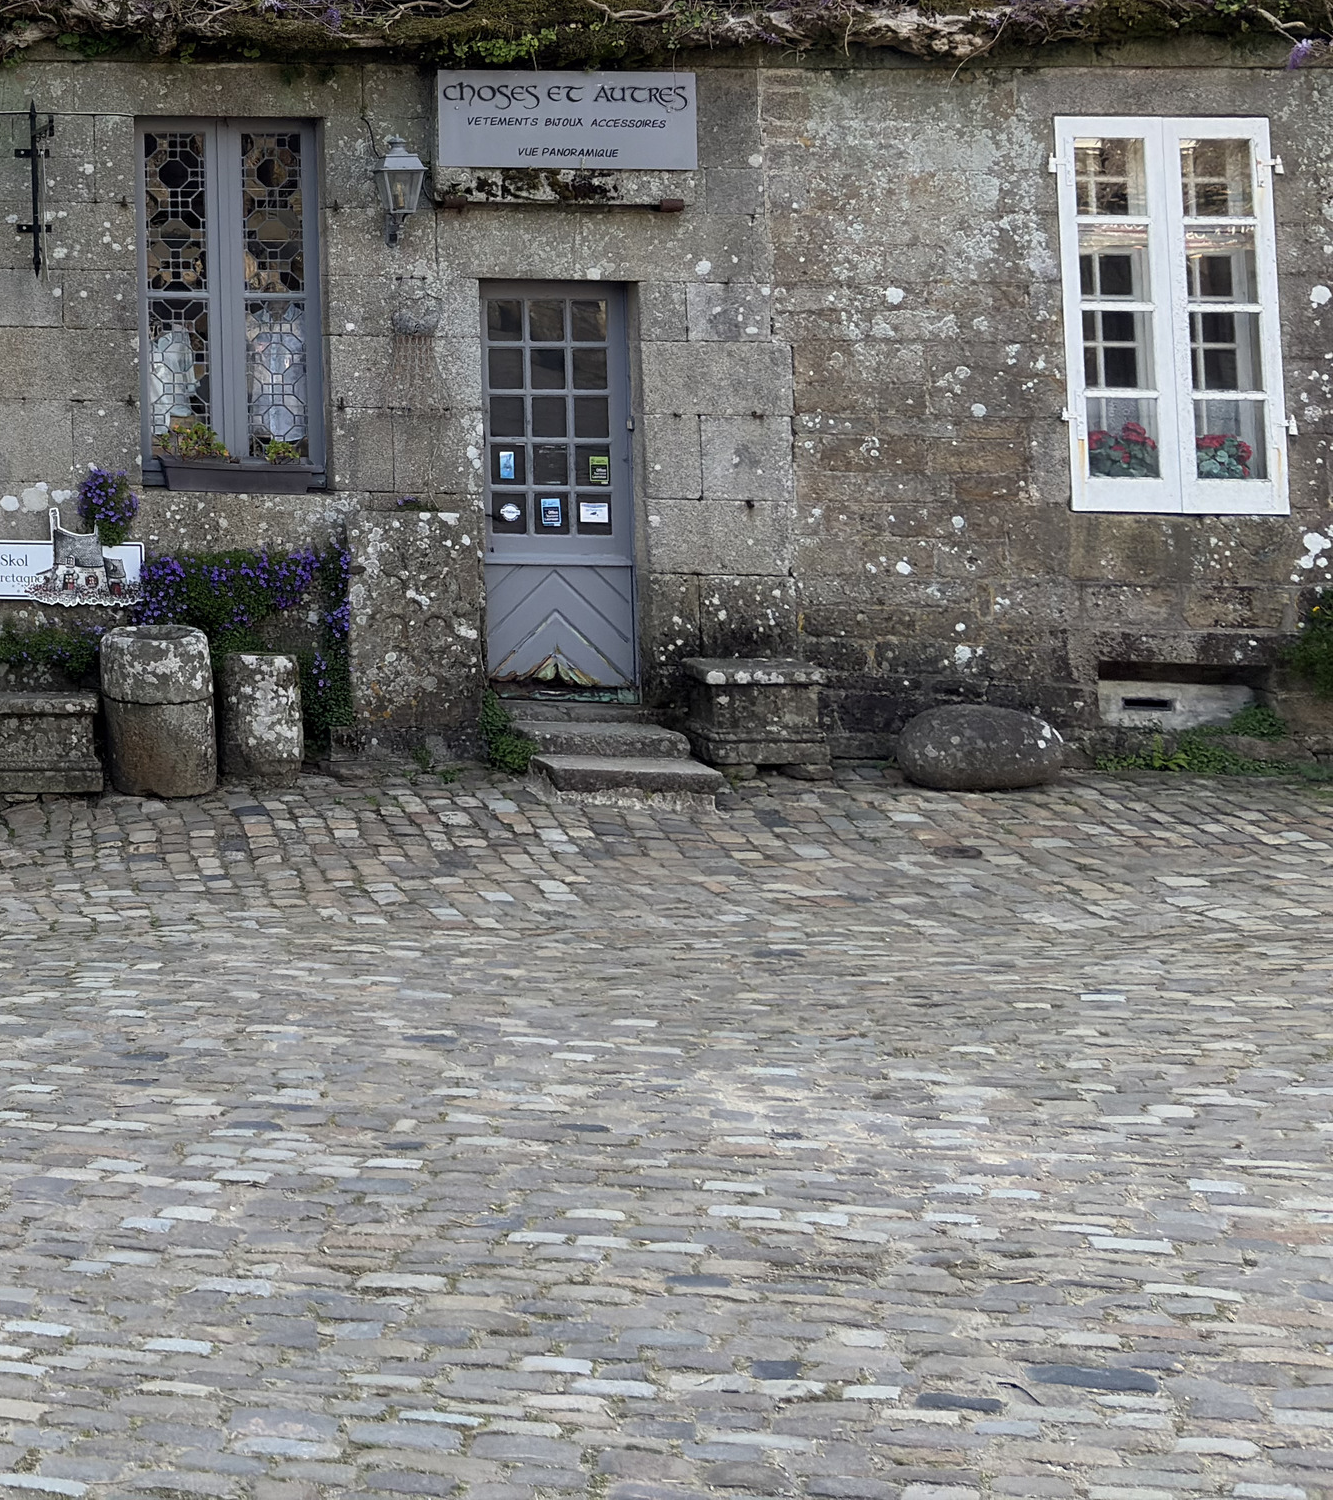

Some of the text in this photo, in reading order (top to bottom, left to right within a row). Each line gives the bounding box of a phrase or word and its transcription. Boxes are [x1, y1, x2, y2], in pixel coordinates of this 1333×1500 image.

[443, 81, 689, 110] CHOSES ET AUTRES
[467, 116, 666, 128] VETEMENTS BIJOUX ACCESSOIRES
[518, 147, 619, 158] VUE PANORAMIQUE
[0, 554, 29, 567] Skol
